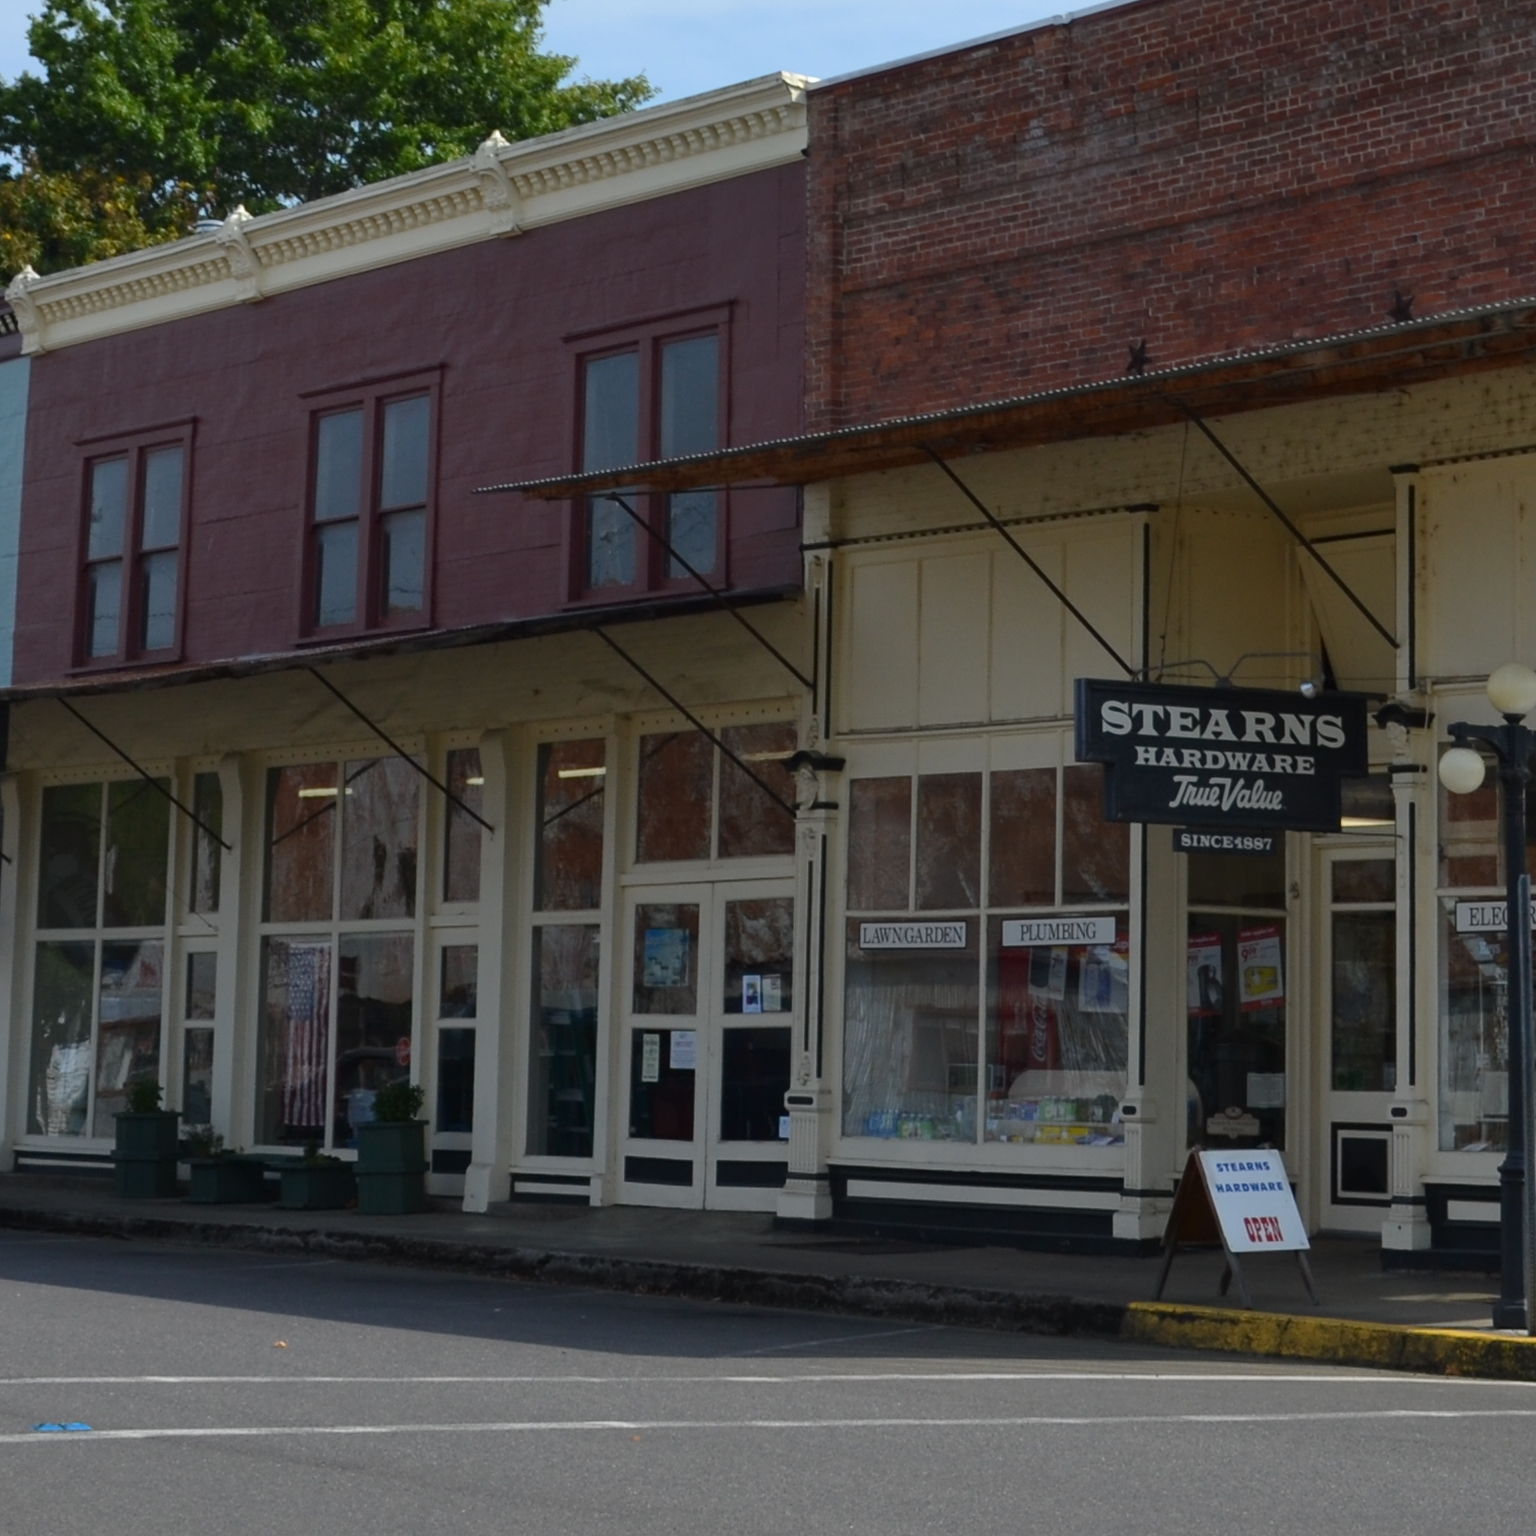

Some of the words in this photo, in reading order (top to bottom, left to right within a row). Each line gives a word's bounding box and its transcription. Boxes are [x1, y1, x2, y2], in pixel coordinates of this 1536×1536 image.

[1101, 700, 1345, 748] STEARNS
[1134, 746, 1315, 775] HARDWARE
[1180, 833, 1233, 849] SINCE
[1234, 836, 1273, 851] 1887
[1020, 922, 1097, 942] PLUMBING
[1216, 1161, 1270, 1173] STEARNS
[1216, 1181, 1285, 1194] HARDWARE
[1243, 1216, 1284, 1243] OPEN
